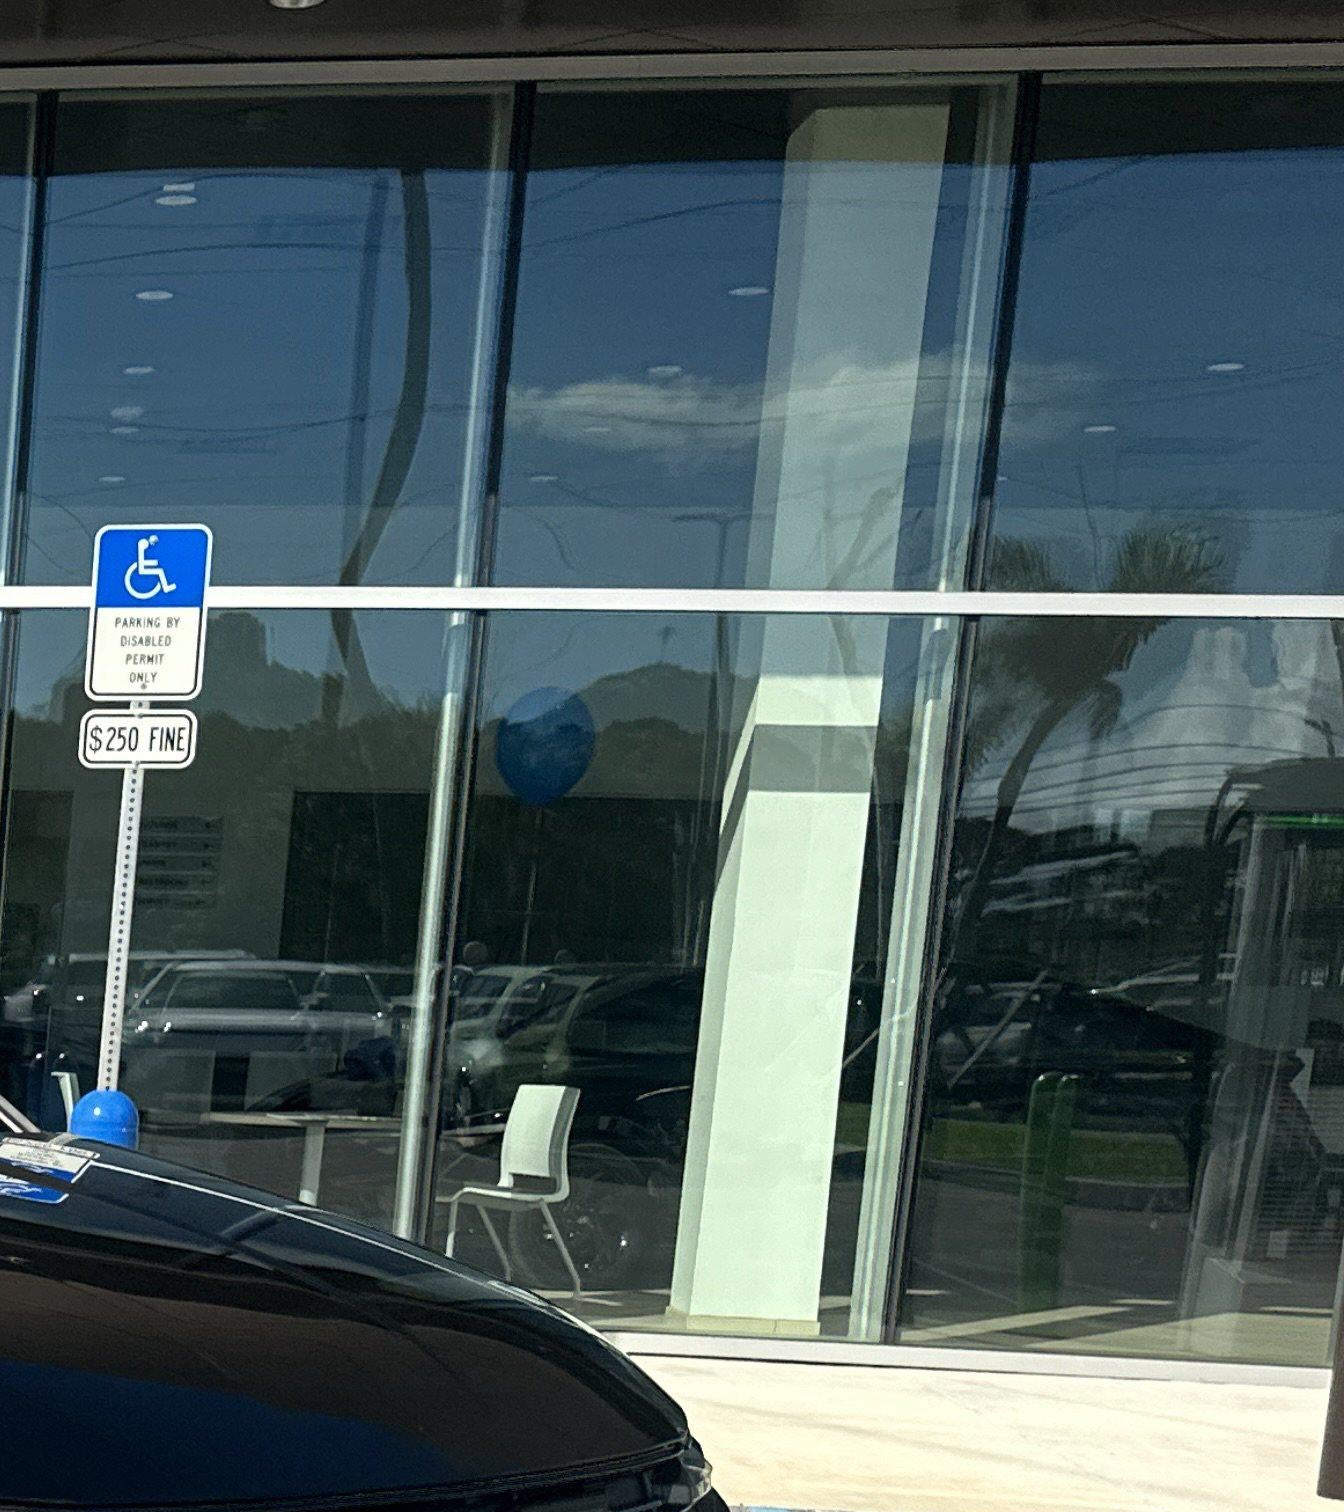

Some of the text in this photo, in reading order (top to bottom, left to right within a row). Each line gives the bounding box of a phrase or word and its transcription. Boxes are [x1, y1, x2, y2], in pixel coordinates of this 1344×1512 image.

[115, 617, 180, 629] PARKING BY
[121, 635, 171, 647] DISABLED
[126, 654, 164, 665] PERMIT
[130, 672, 158, 683] ONLY
[89, 725, 186, 753] $250 FINE
